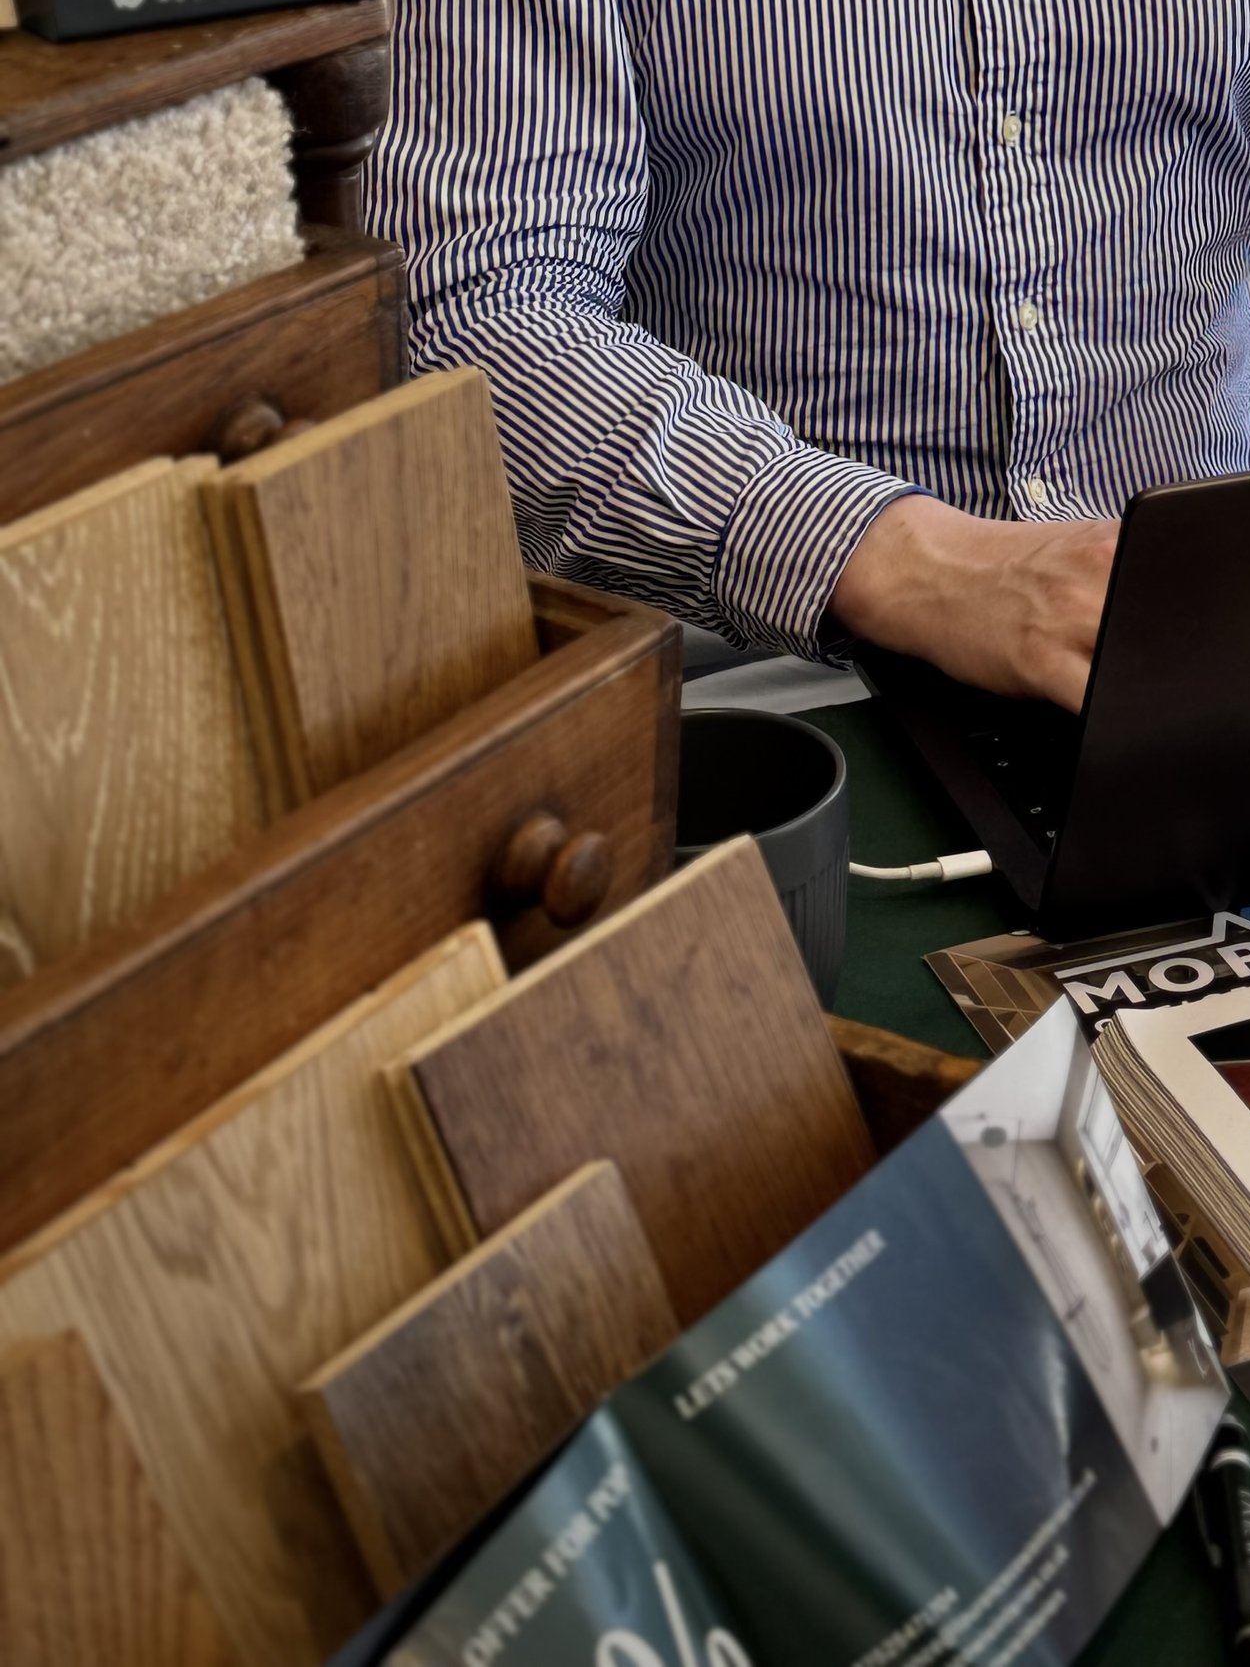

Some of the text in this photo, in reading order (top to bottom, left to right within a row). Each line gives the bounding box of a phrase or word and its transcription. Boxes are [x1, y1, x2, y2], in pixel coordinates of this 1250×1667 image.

[729, 1311, 799, 1372] WORK
[791, 1228, 888, 1320] TOGETHER
[541, 1509, 598, 1580] FOR
